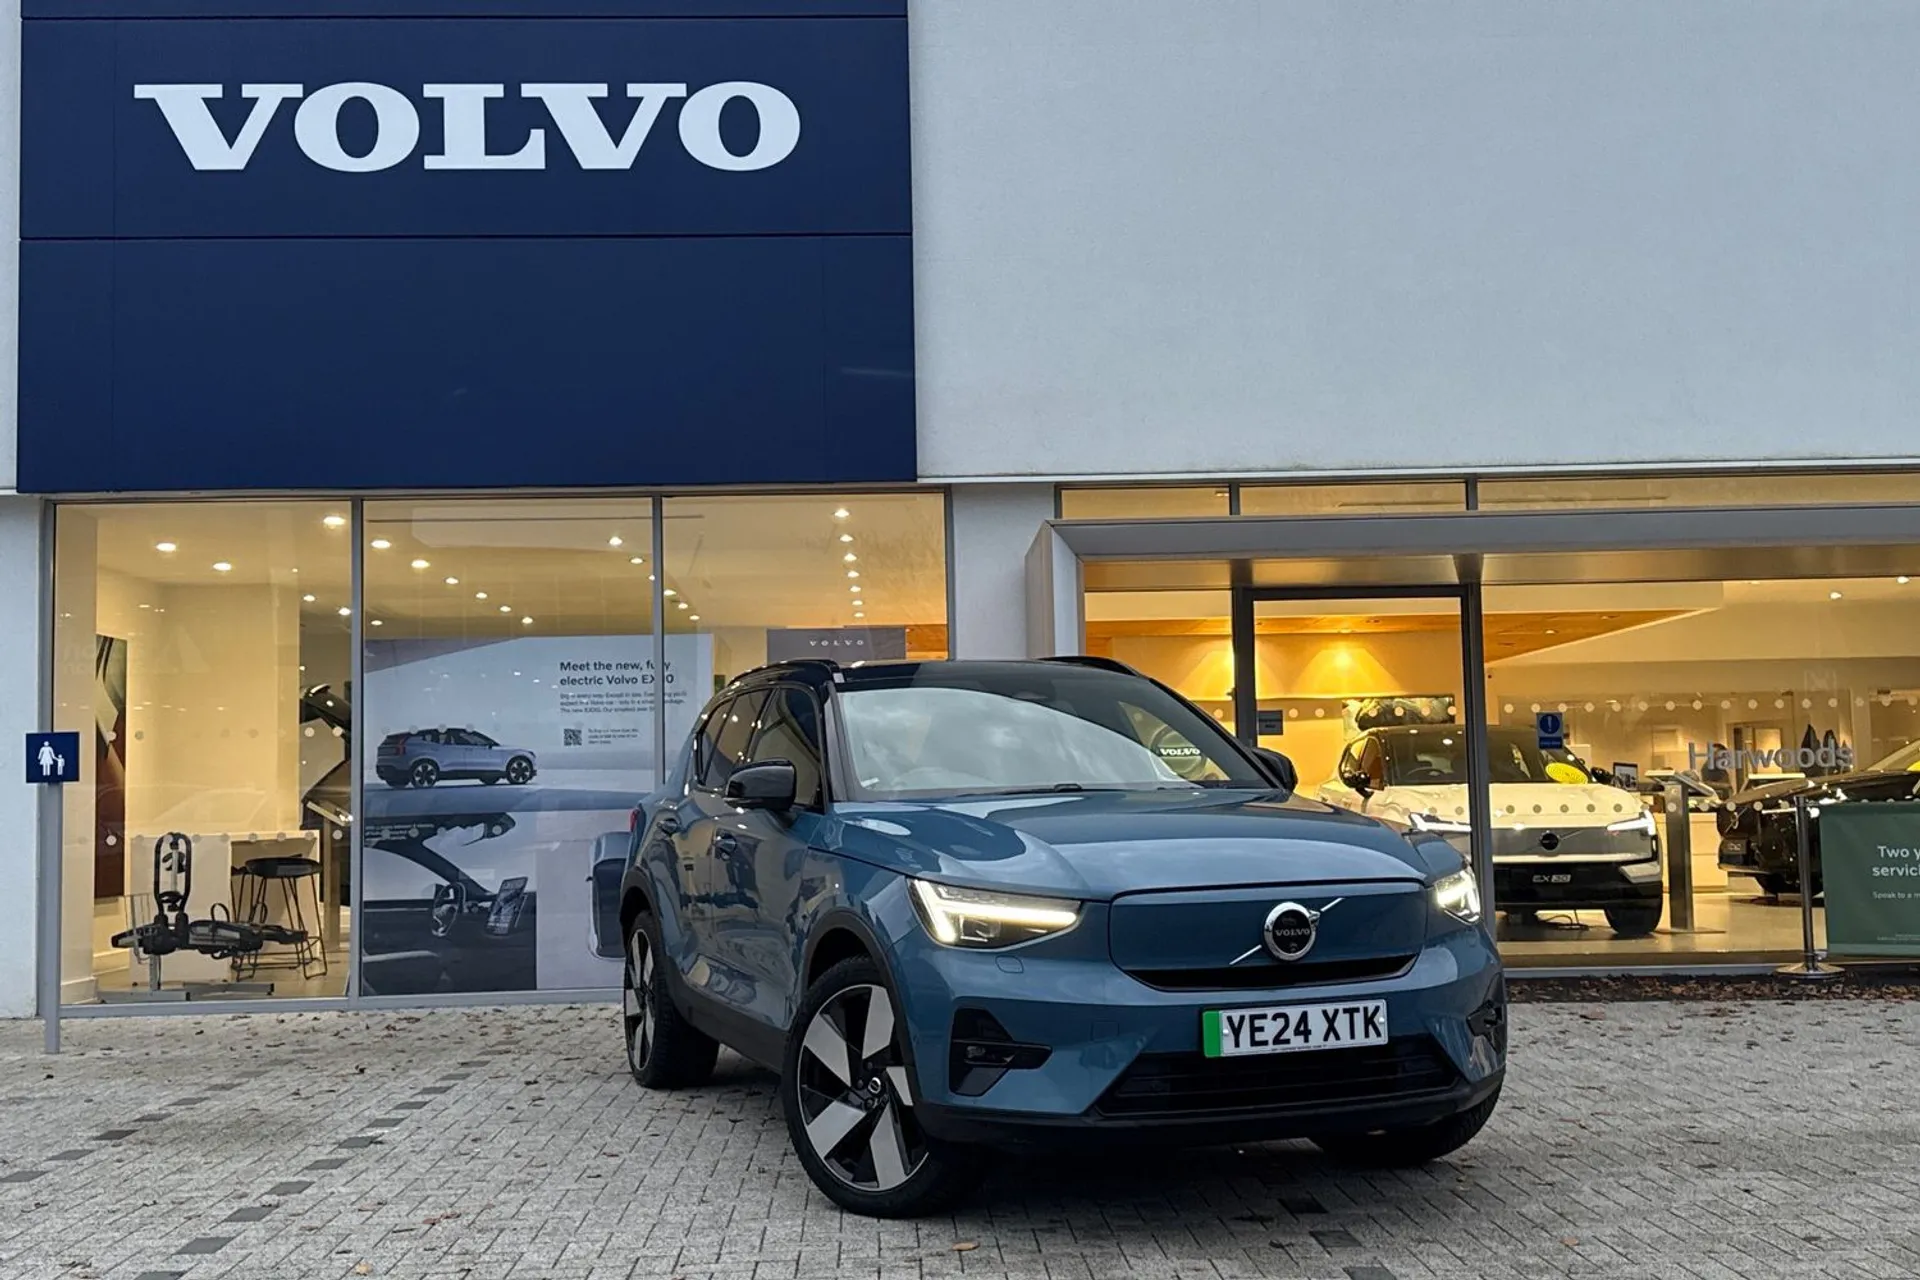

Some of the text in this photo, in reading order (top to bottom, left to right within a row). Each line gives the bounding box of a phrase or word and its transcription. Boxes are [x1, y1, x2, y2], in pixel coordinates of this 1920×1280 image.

[133, 81, 801, 172] VOLVO
[809, 639, 864, 647] VOLVO
[560, 660, 671, 672] Meet the new, fuy
[560, 674, 674, 686] electric Volvo EX0
[1160, 747, 1201, 756] VOLVO
[1688, 735, 1853, 770] Harwoods
[1877, 845, 1910, 858] Two
[1275, 928, 1310, 937] VOLVO
[1226, 1005, 1382, 1048] YE24 XTK
